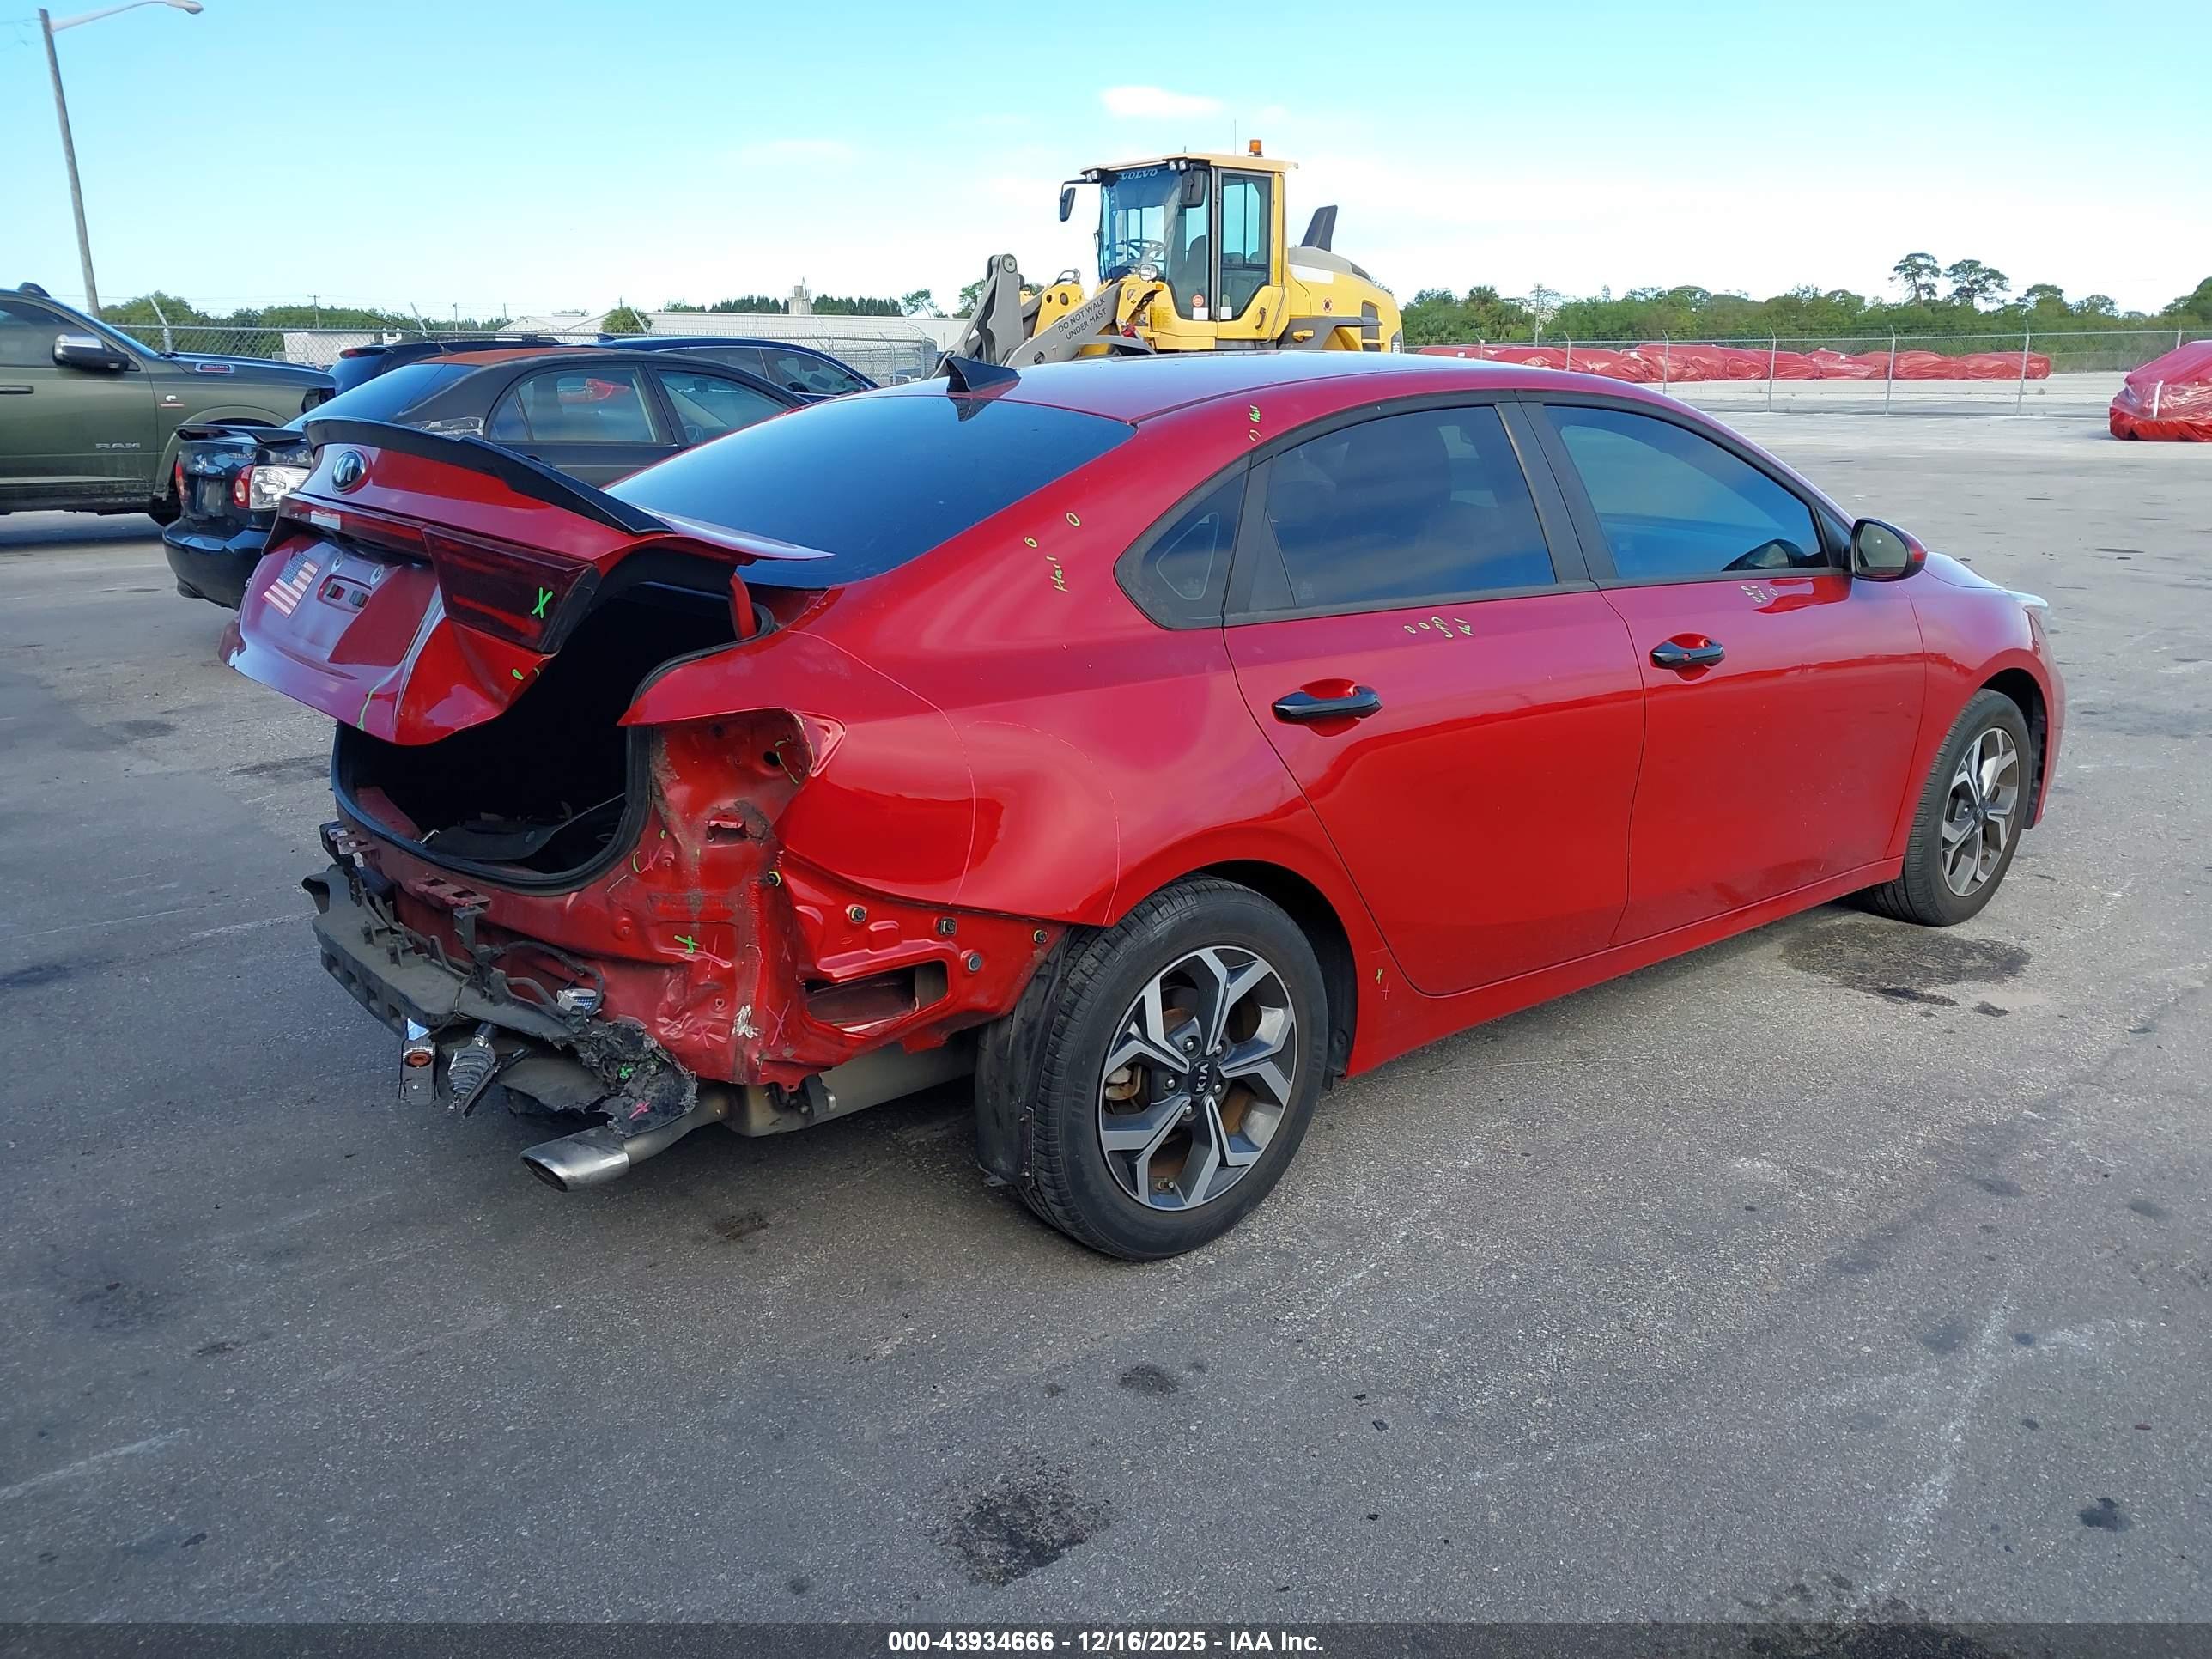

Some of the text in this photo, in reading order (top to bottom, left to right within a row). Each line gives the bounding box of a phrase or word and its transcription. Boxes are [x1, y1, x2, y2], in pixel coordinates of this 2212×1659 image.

[1120, 168, 1158, 181] VOLVO
[1058, 296, 1106, 333] DO NOT WALK
[1065, 307, 1108, 340] UNDER MAST
[1195, 1063, 1209, 1092] KIA
